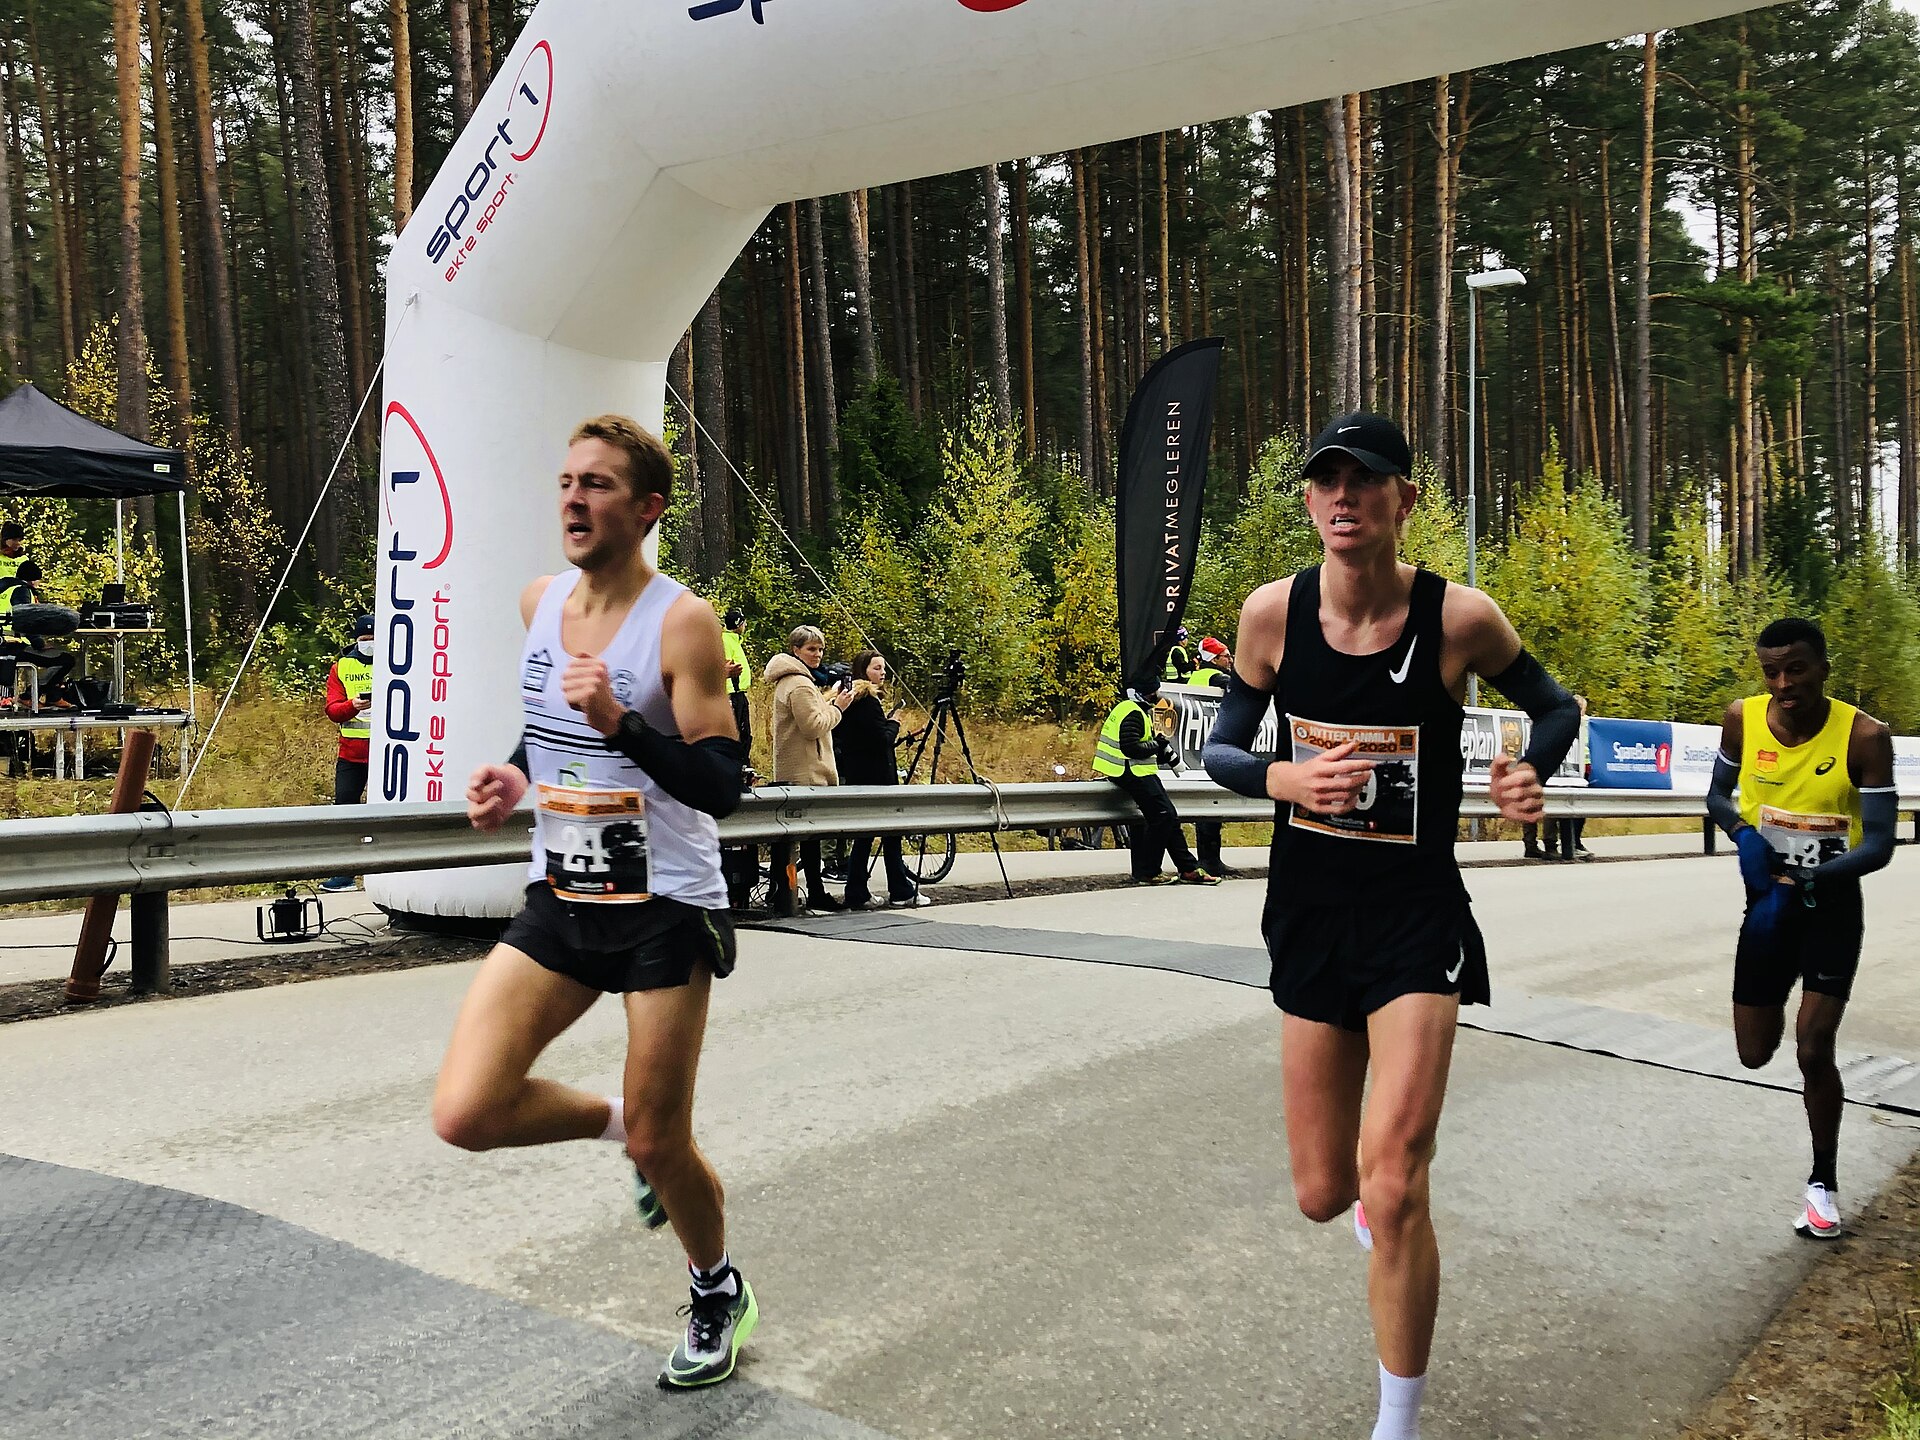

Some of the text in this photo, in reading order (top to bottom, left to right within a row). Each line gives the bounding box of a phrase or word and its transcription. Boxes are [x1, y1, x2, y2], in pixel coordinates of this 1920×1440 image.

[426, 82, 539, 264] sport 1
[445, 173, 515, 282] ekte sport
[1165, 400, 1181, 612] PRIVATMEGLEREN
[383, 471, 421, 802] sport 1
[427, 590, 452, 803] ekte sport
[1359, 743, 1397, 752] 2020
[561, 826, 612, 873] 21
[1784, 836, 1821, 868] 18
